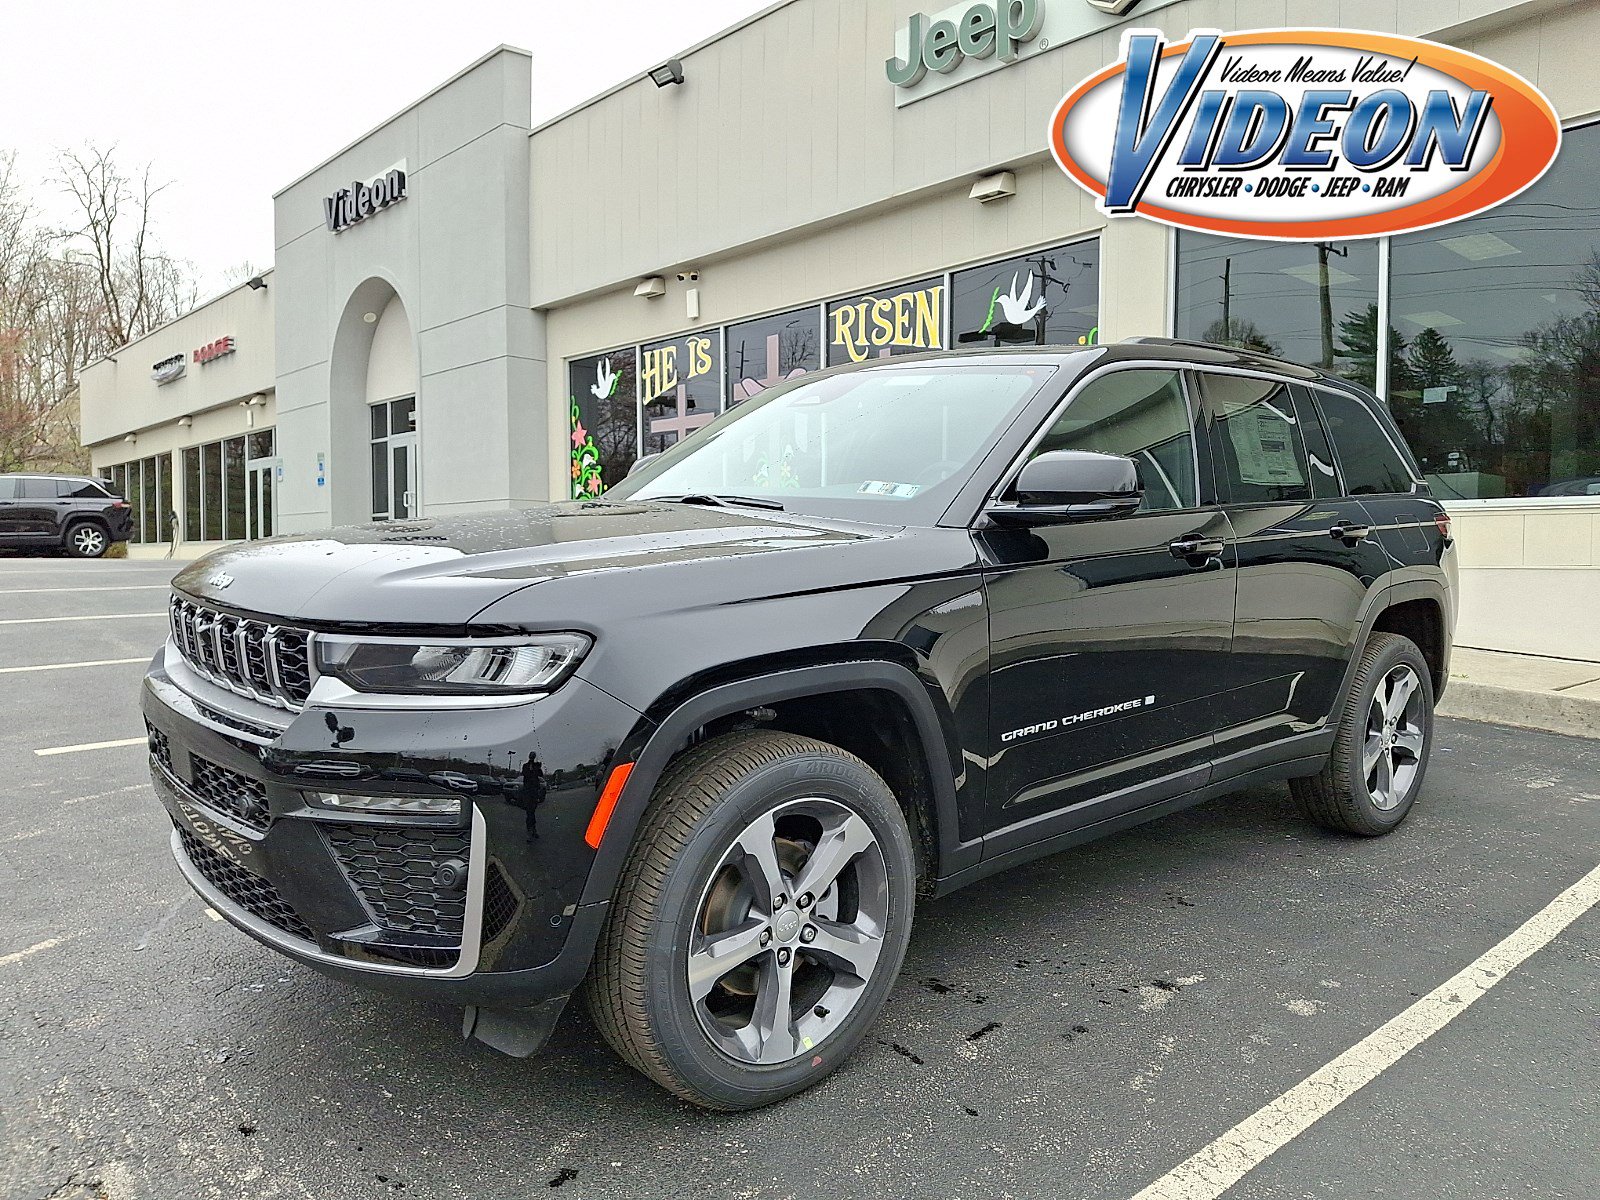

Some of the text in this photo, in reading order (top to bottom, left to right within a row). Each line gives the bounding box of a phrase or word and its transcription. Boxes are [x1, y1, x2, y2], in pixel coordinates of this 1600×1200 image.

[885, 0, 1045, 87] Jeep
[323, 169, 405, 232] Videon
[829, 286, 944, 362] RISEN
[642, 337, 712, 405] HE IS
[1001, 699, 1142, 741] GRAND CHEROKEE
